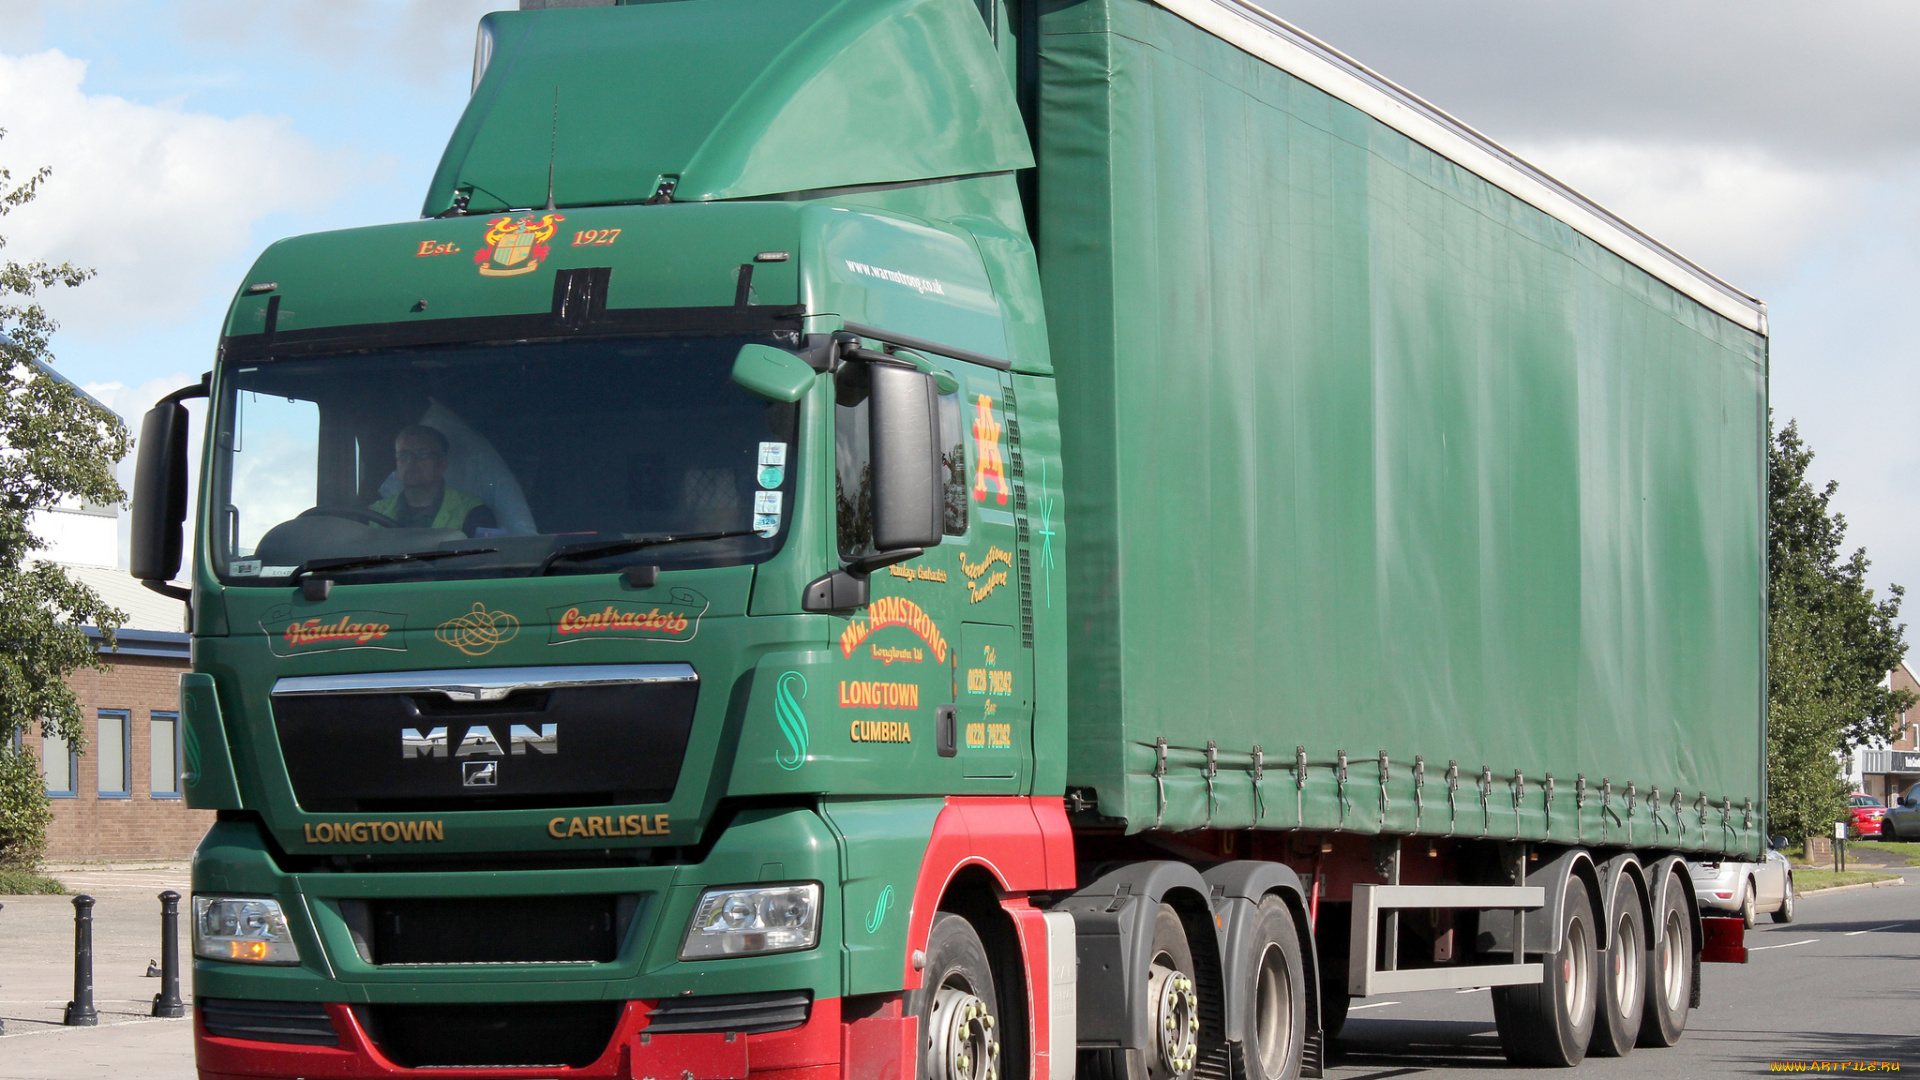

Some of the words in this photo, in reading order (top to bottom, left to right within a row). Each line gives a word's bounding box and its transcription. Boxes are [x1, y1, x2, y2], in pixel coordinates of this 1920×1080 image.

[416, 240, 461, 257] Est.
[571, 228, 621, 247] 1927
[845, 260, 944, 295] www.warmstrong.co.uk
[284, 616, 390, 647] Haulage
[558, 606, 688, 635] Contractors
[868, 596, 947, 664] ARMSTRONG
[839, 680, 918, 710] LONGTOWN
[402, 723, 557, 758] MAN
[850, 720, 911, 744] CUMBRIA
[304, 820, 444, 843] LONGTOWN
[548, 814, 670, 838] CARLISLE
